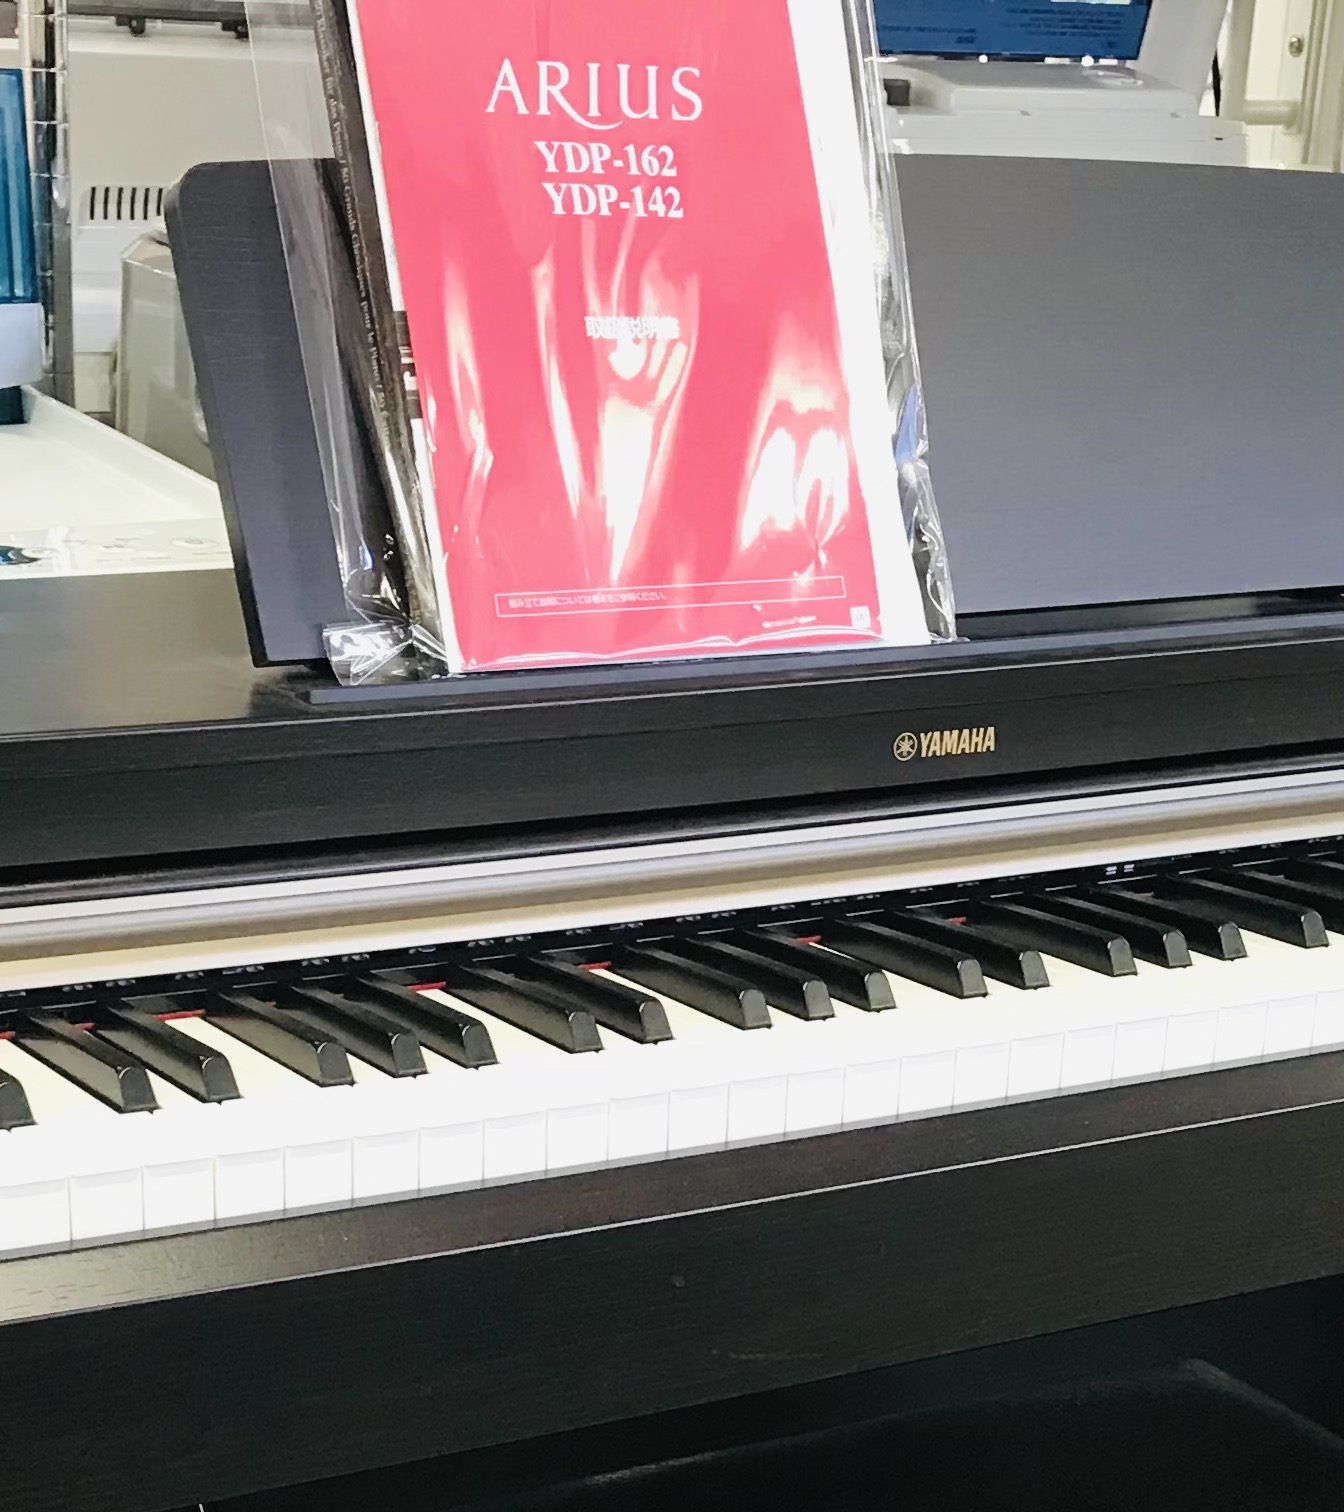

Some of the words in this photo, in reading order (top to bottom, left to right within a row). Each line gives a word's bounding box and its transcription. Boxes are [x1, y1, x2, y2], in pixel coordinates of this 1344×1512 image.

[485, 57, 704, 130] ARIUS
[533, 141, 678, 177] YDP-162
[541, 182, 685, 218] YDP-142
[918, 716, 996, 758] YAMAHA
